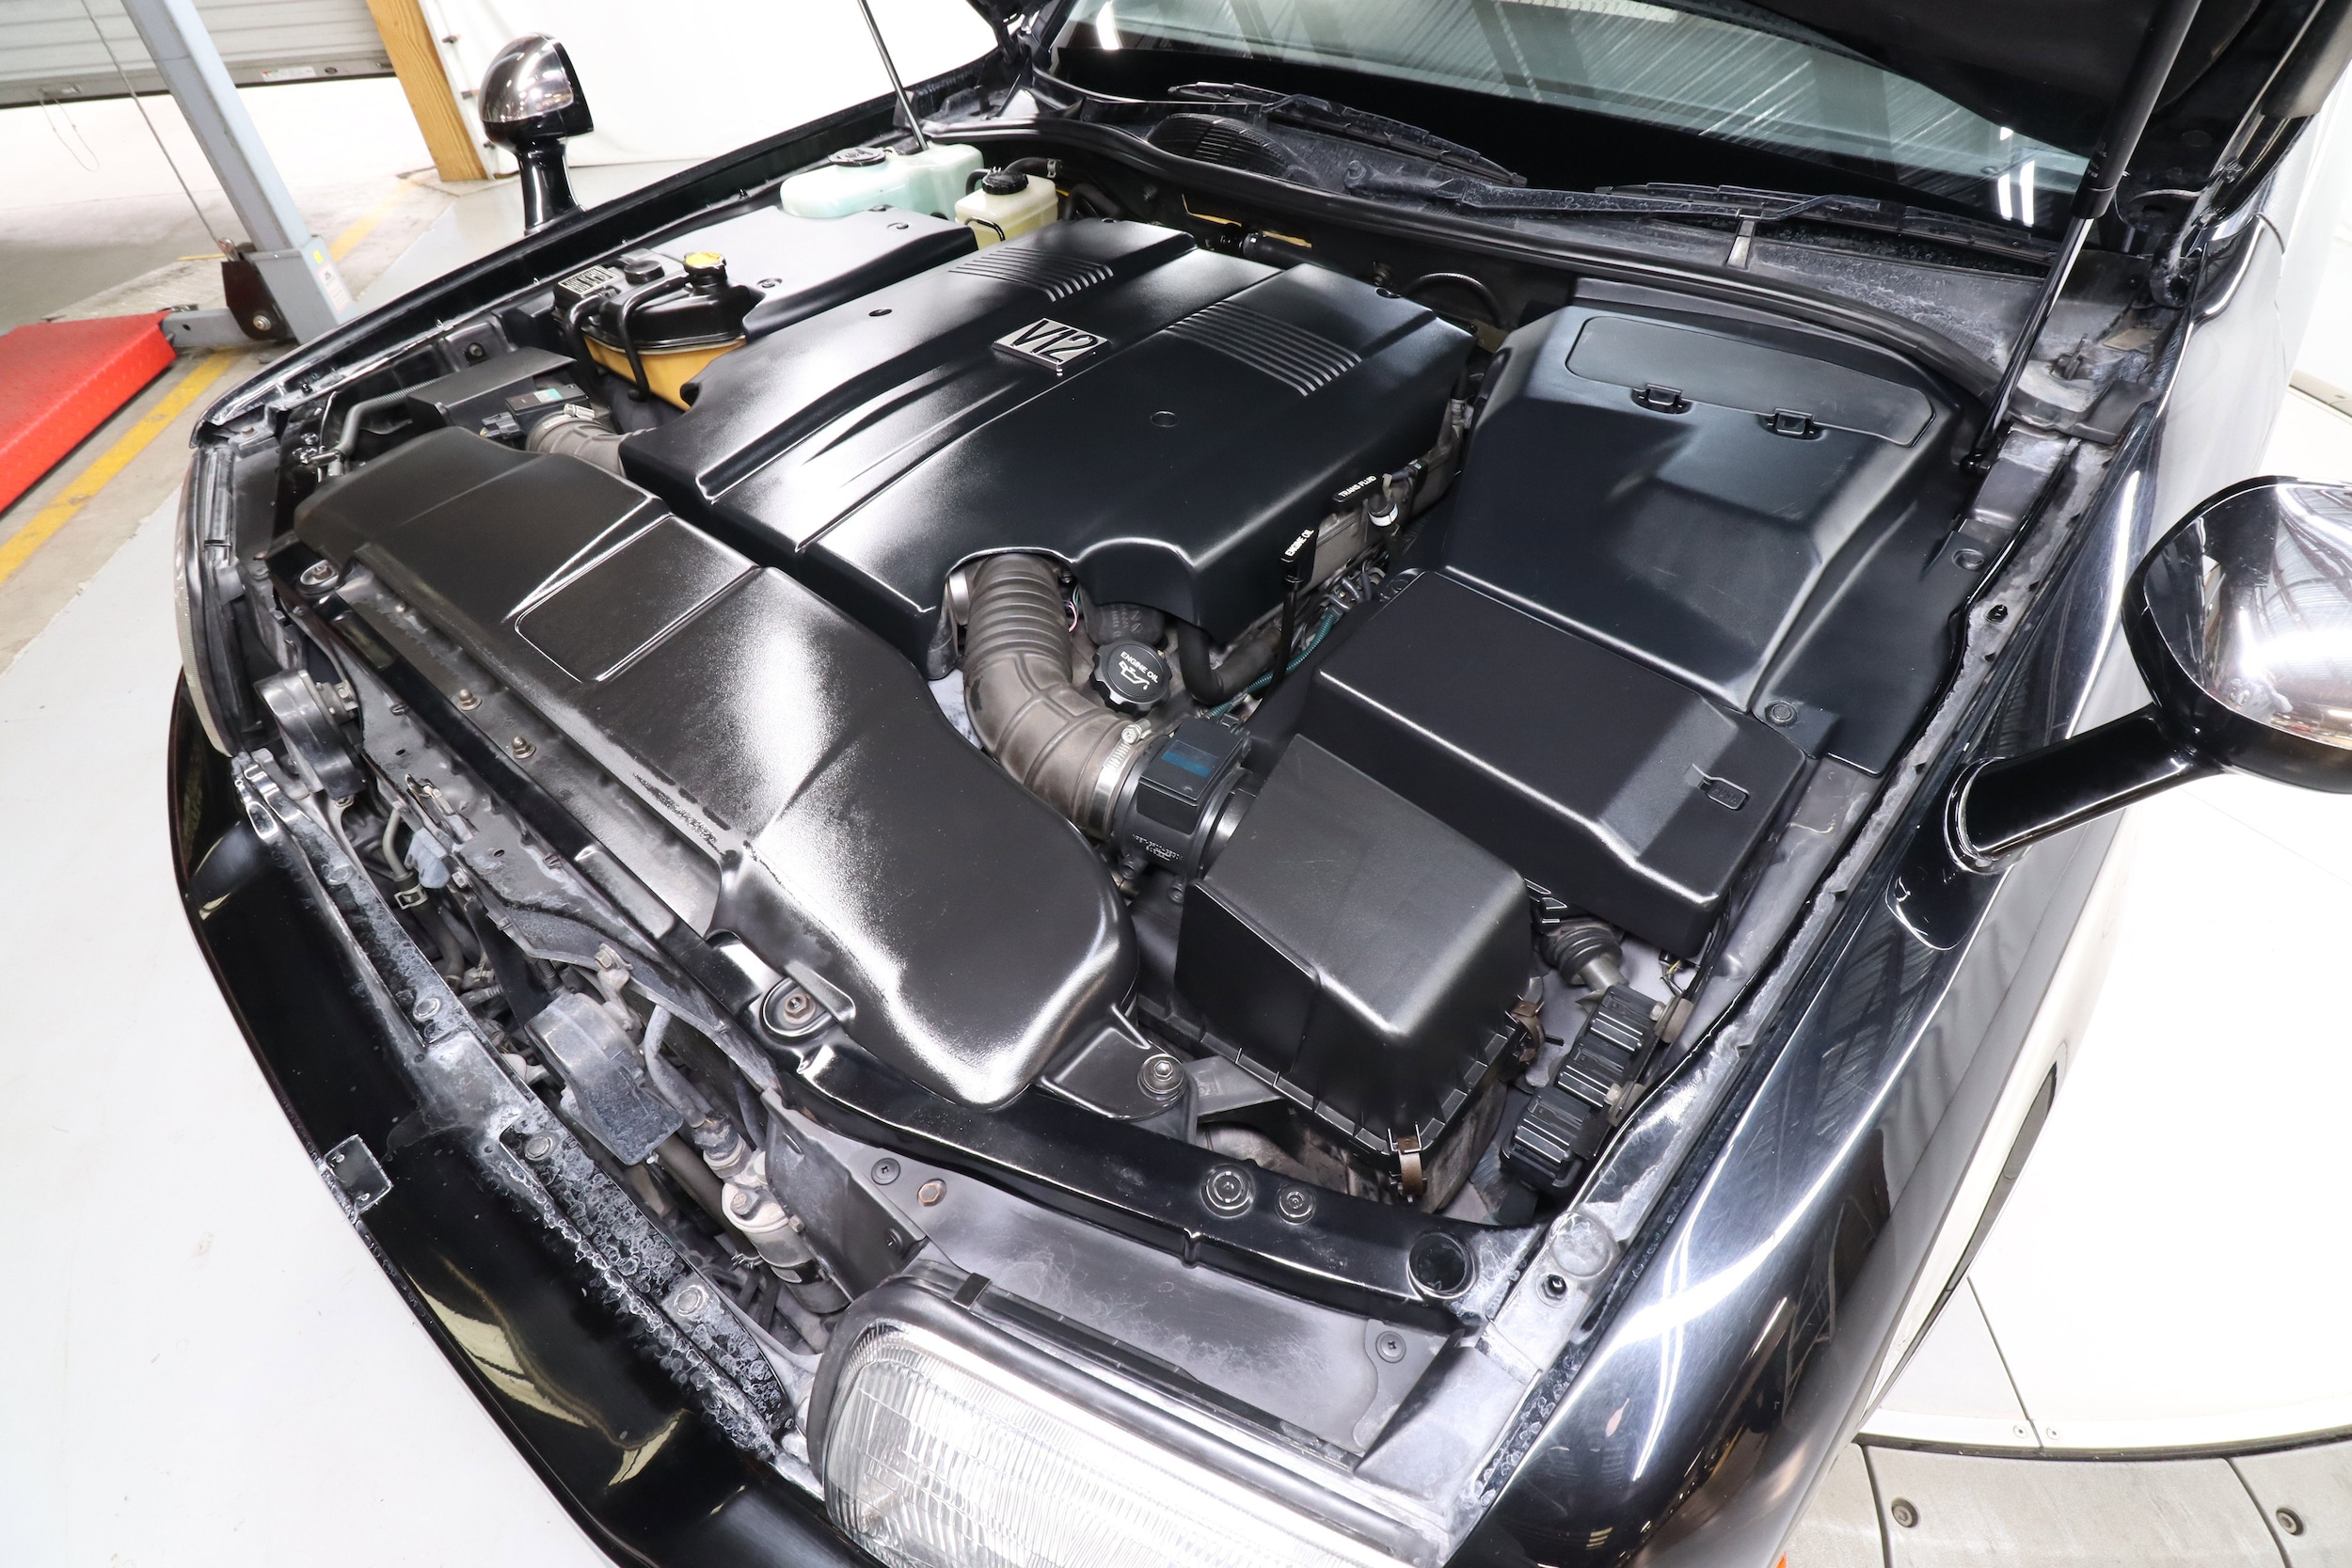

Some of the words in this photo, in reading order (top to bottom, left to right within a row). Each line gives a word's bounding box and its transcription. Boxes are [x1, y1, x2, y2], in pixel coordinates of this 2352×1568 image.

[1010, 320, 1099, 363] V12
[1338, 483, 1360, 498] TRANS
[1359, 475, 1377, 487] FLUID
[1285, 536, 1307, 557] ENGINE
[1301, 529, 1314, 539] OIL
[1120, 651, 1148, 673] ENGINE
[1147, 671, 1159, 684] OIL
